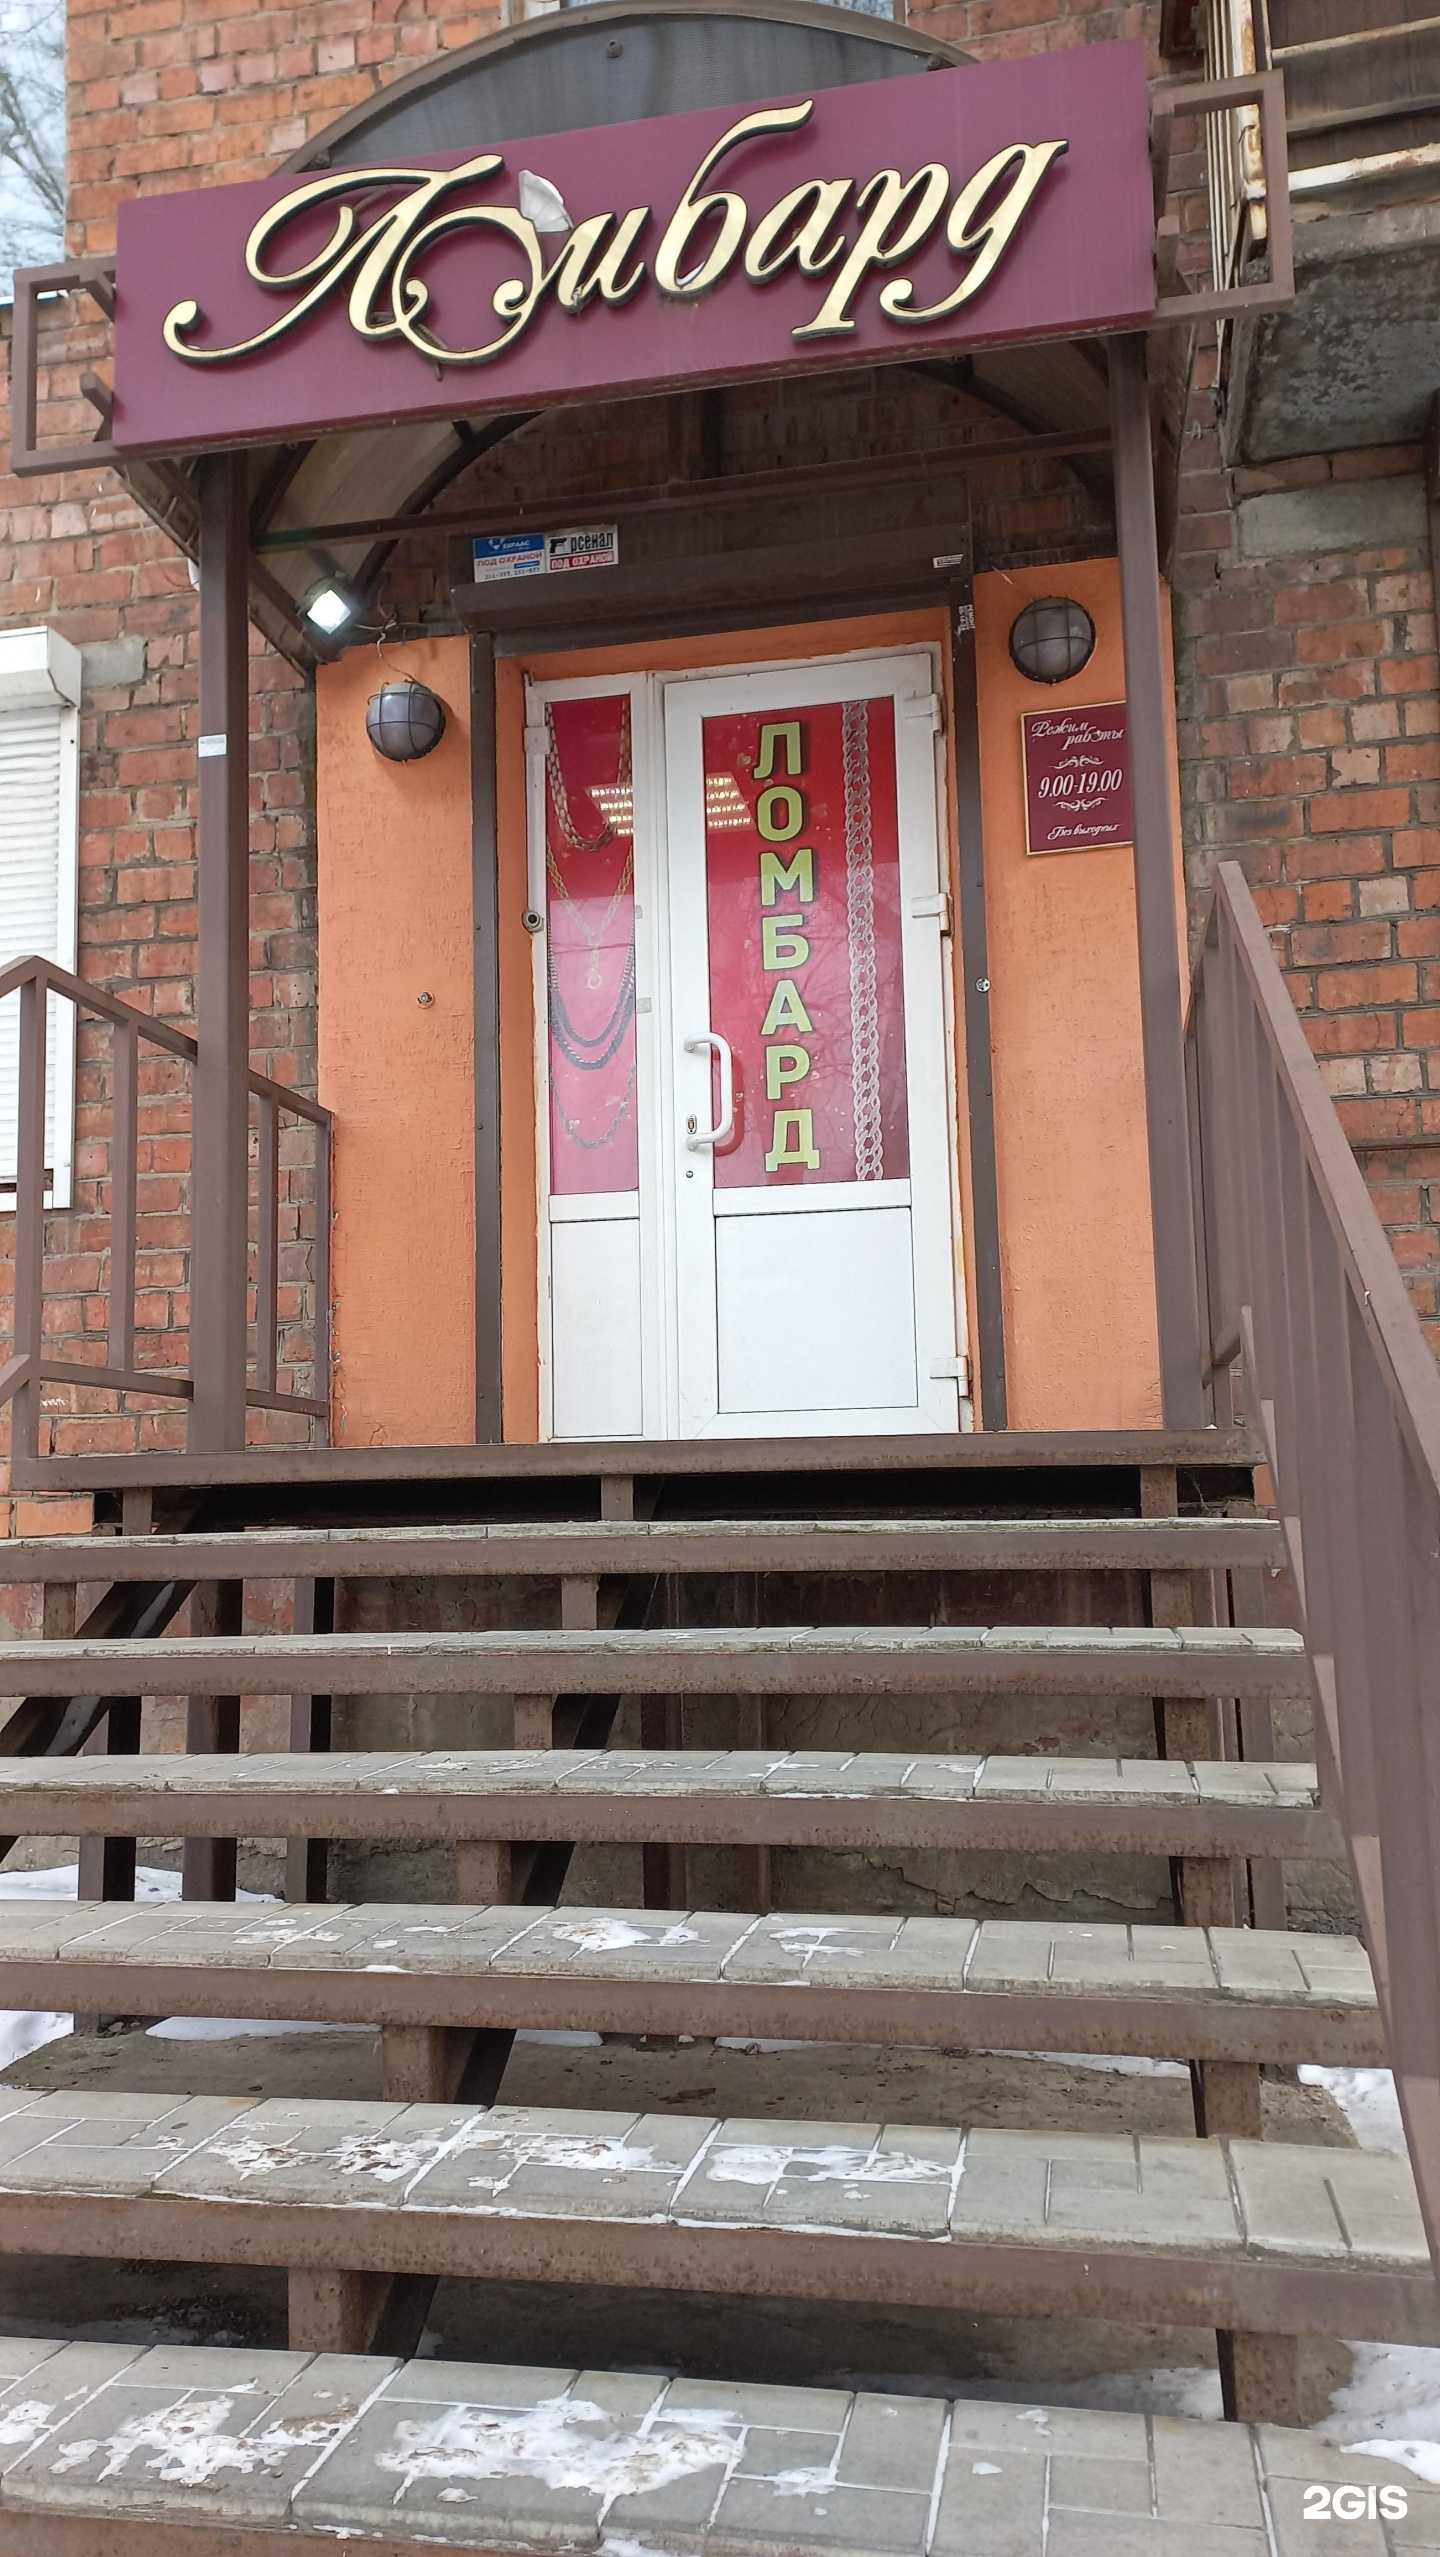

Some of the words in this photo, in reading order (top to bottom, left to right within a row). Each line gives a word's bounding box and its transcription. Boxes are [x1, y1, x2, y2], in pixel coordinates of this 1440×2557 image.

[551, 559, 570, 570] ПОД
[1032, 717, 1088, 737] Режим
[1061, 726, 1124, 751] работы
[1038, 768, 1123, 798] 9.00-19.00
[752, 721, 820, 1173] ЛОМБАРД
